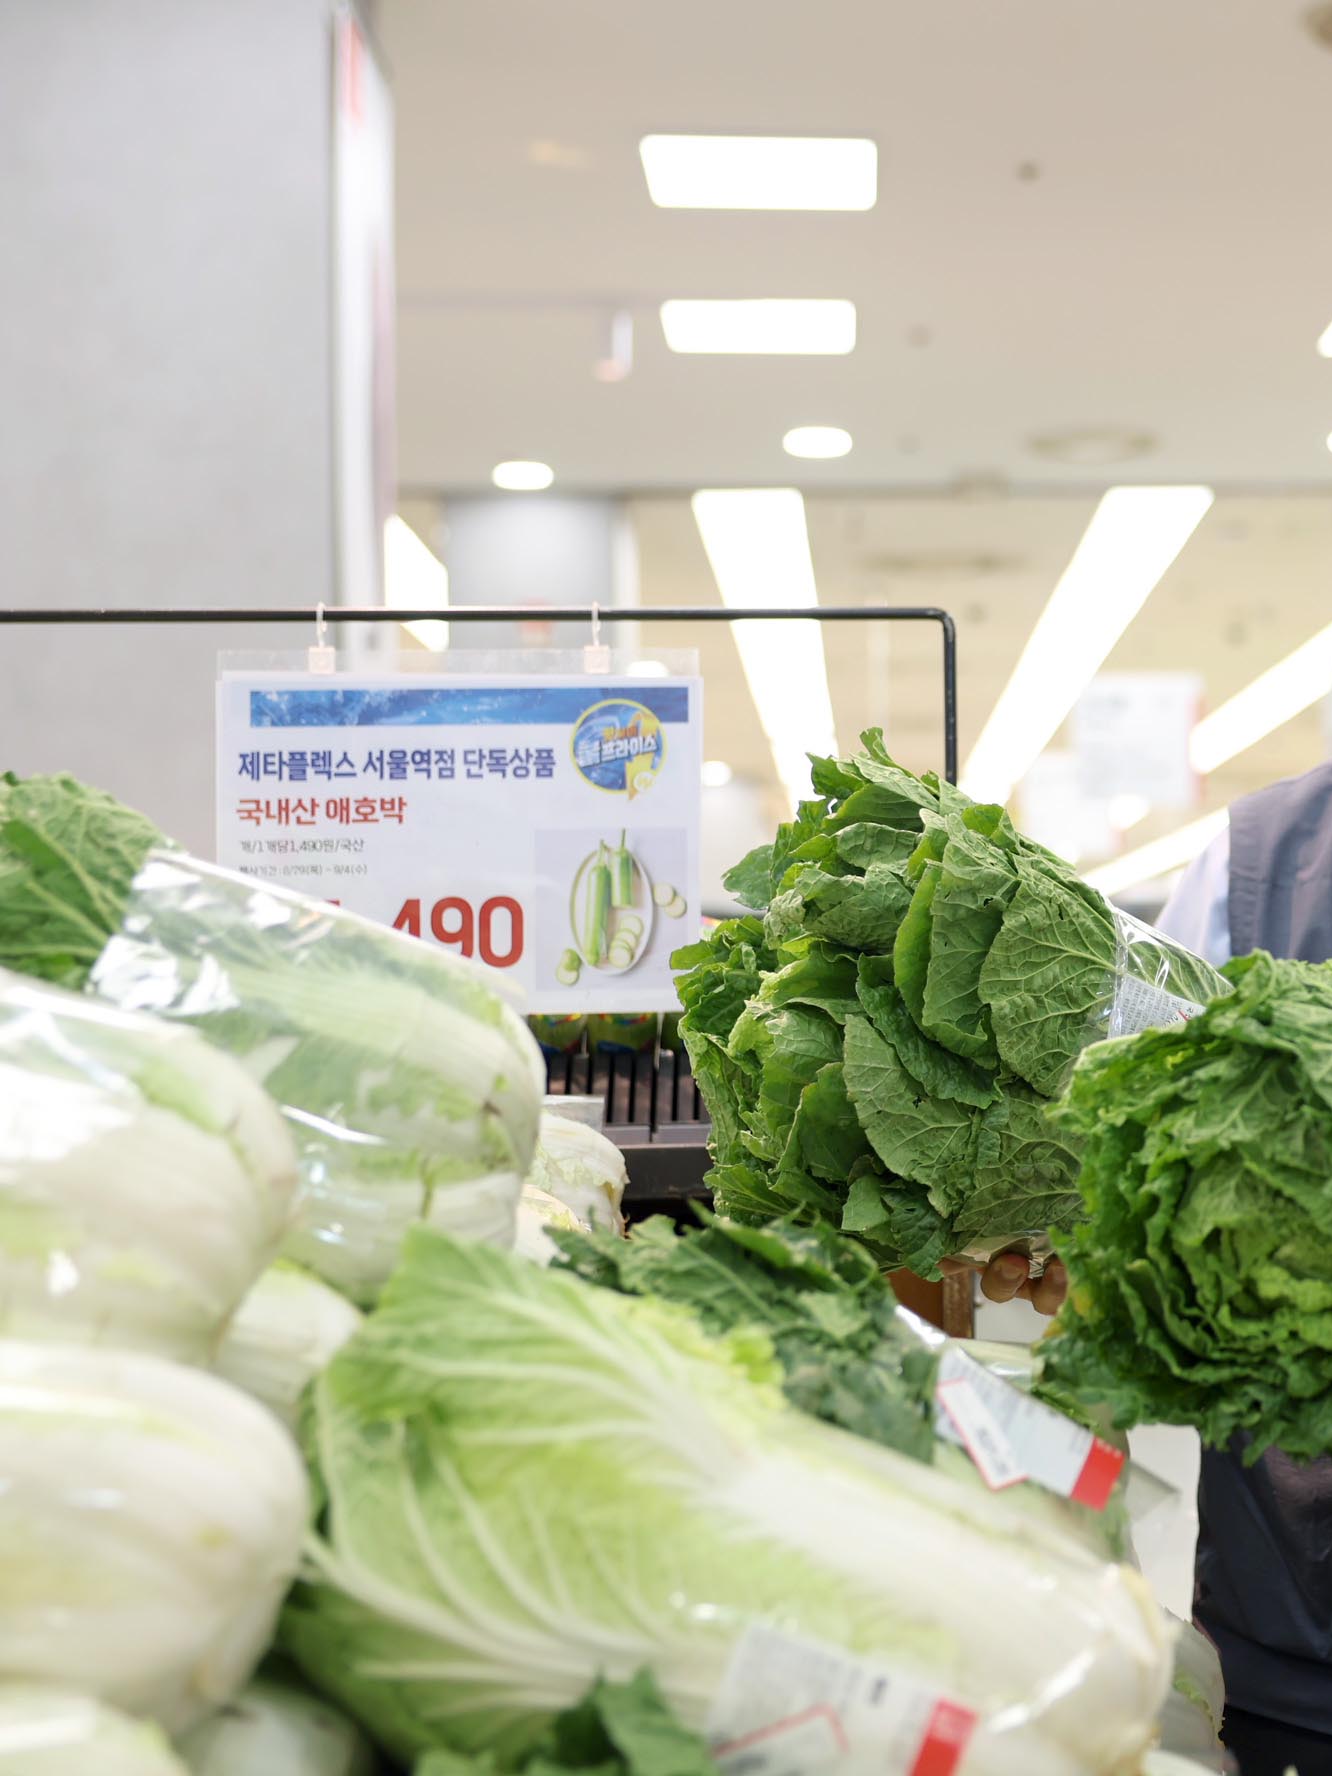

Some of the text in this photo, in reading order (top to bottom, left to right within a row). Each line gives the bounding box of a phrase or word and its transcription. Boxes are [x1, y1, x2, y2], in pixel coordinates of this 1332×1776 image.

[238, 749, 357, 782] 제타플렉스
[362, 748, 456, 781] 서울역점
[463, 747, 556, 779] 단독상품
[236, 796, 407, 827] 국내산 애호박
